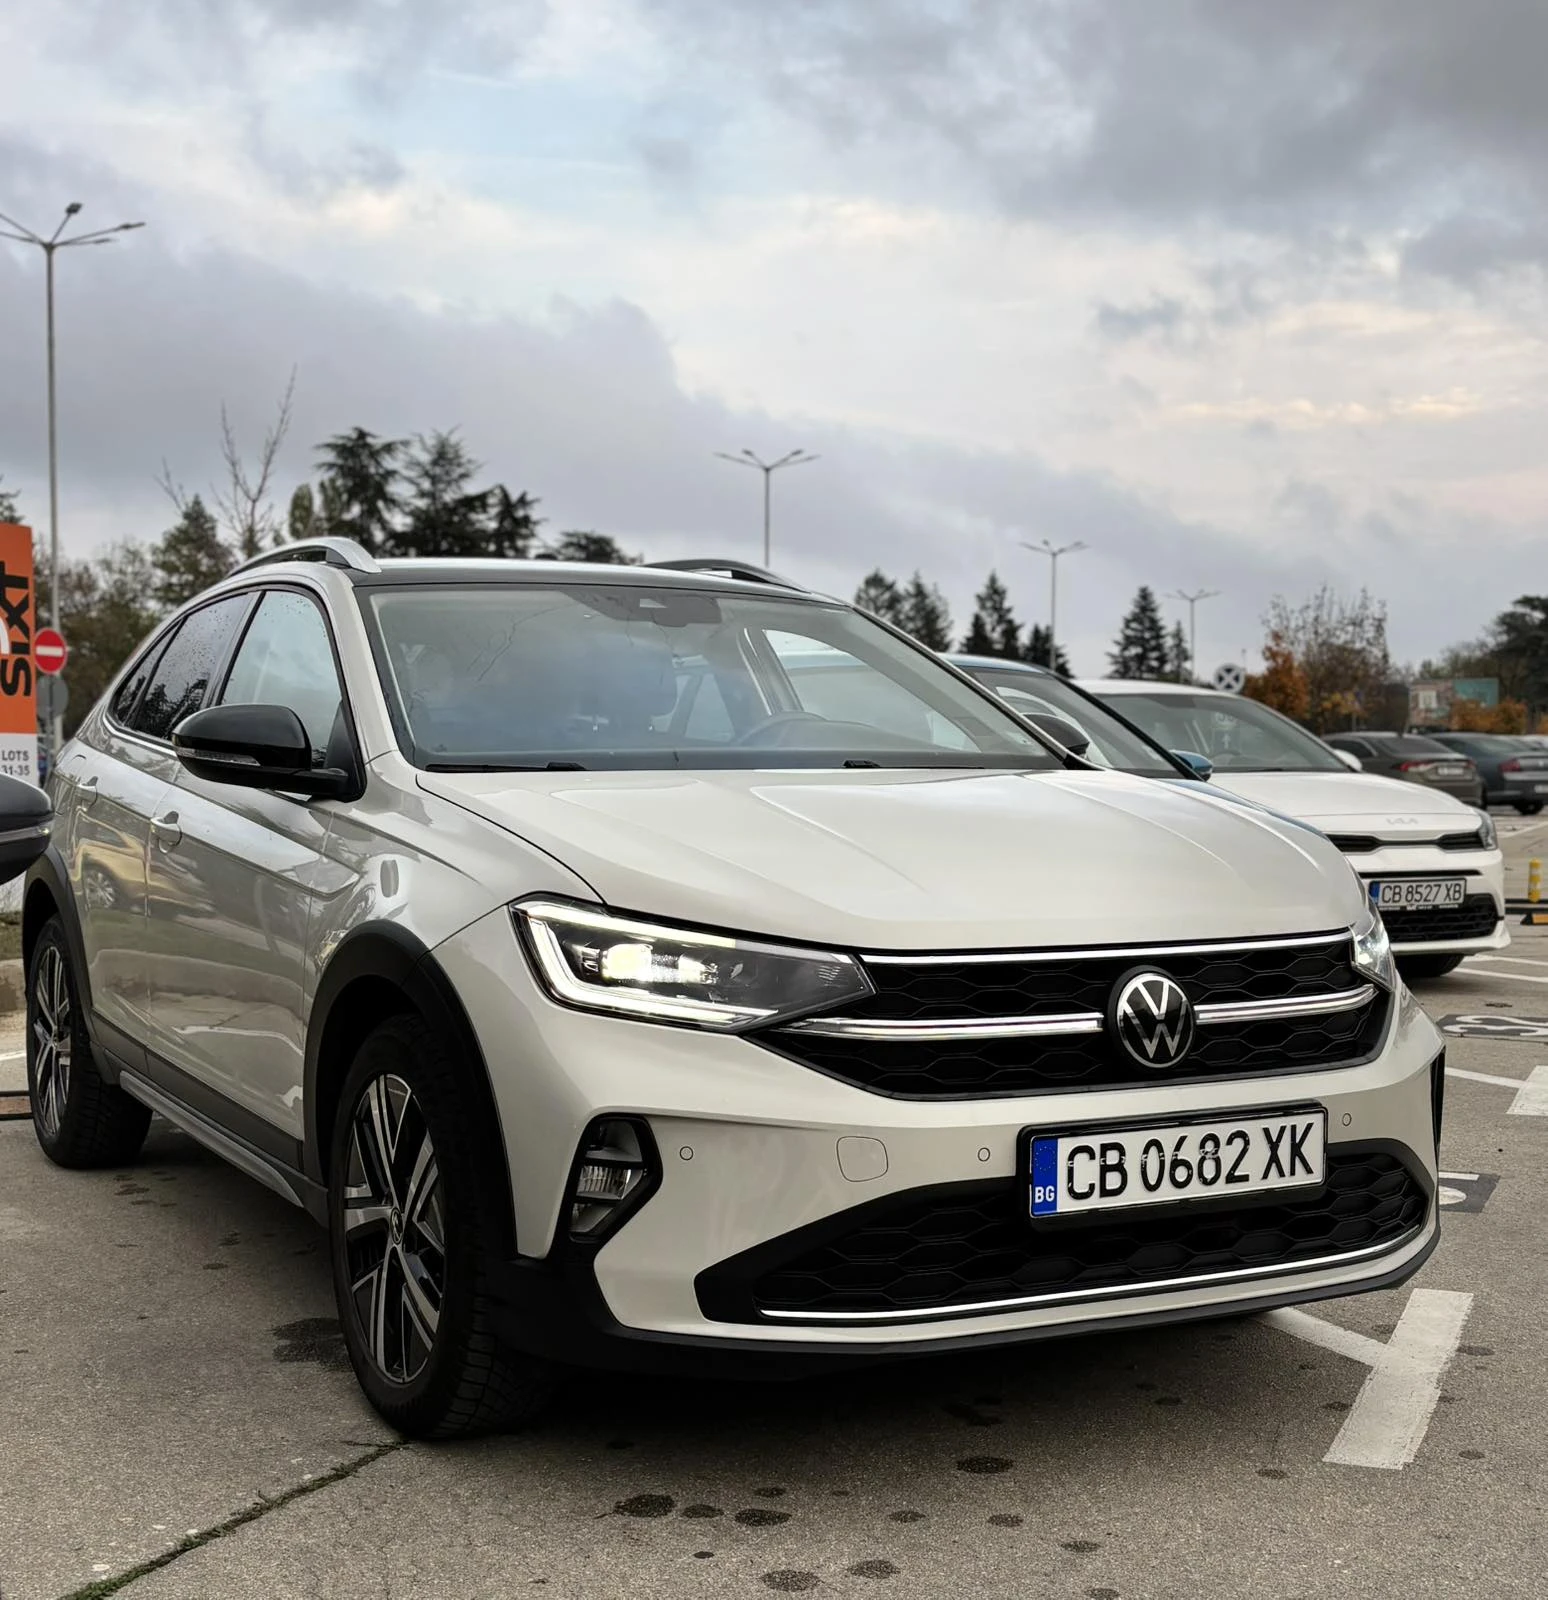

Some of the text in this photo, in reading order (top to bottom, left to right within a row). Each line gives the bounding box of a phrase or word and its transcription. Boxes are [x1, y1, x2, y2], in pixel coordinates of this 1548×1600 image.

[1, 750, 30, 761] LOTS
[1381, 882, 1462, 904] CB 8527 XB
[1117, 972, 1194, 1068] VW
[1066, 1122, 1314, 1201] CB 0682 XK
[1034, 1185, 1056, 1204] BG
